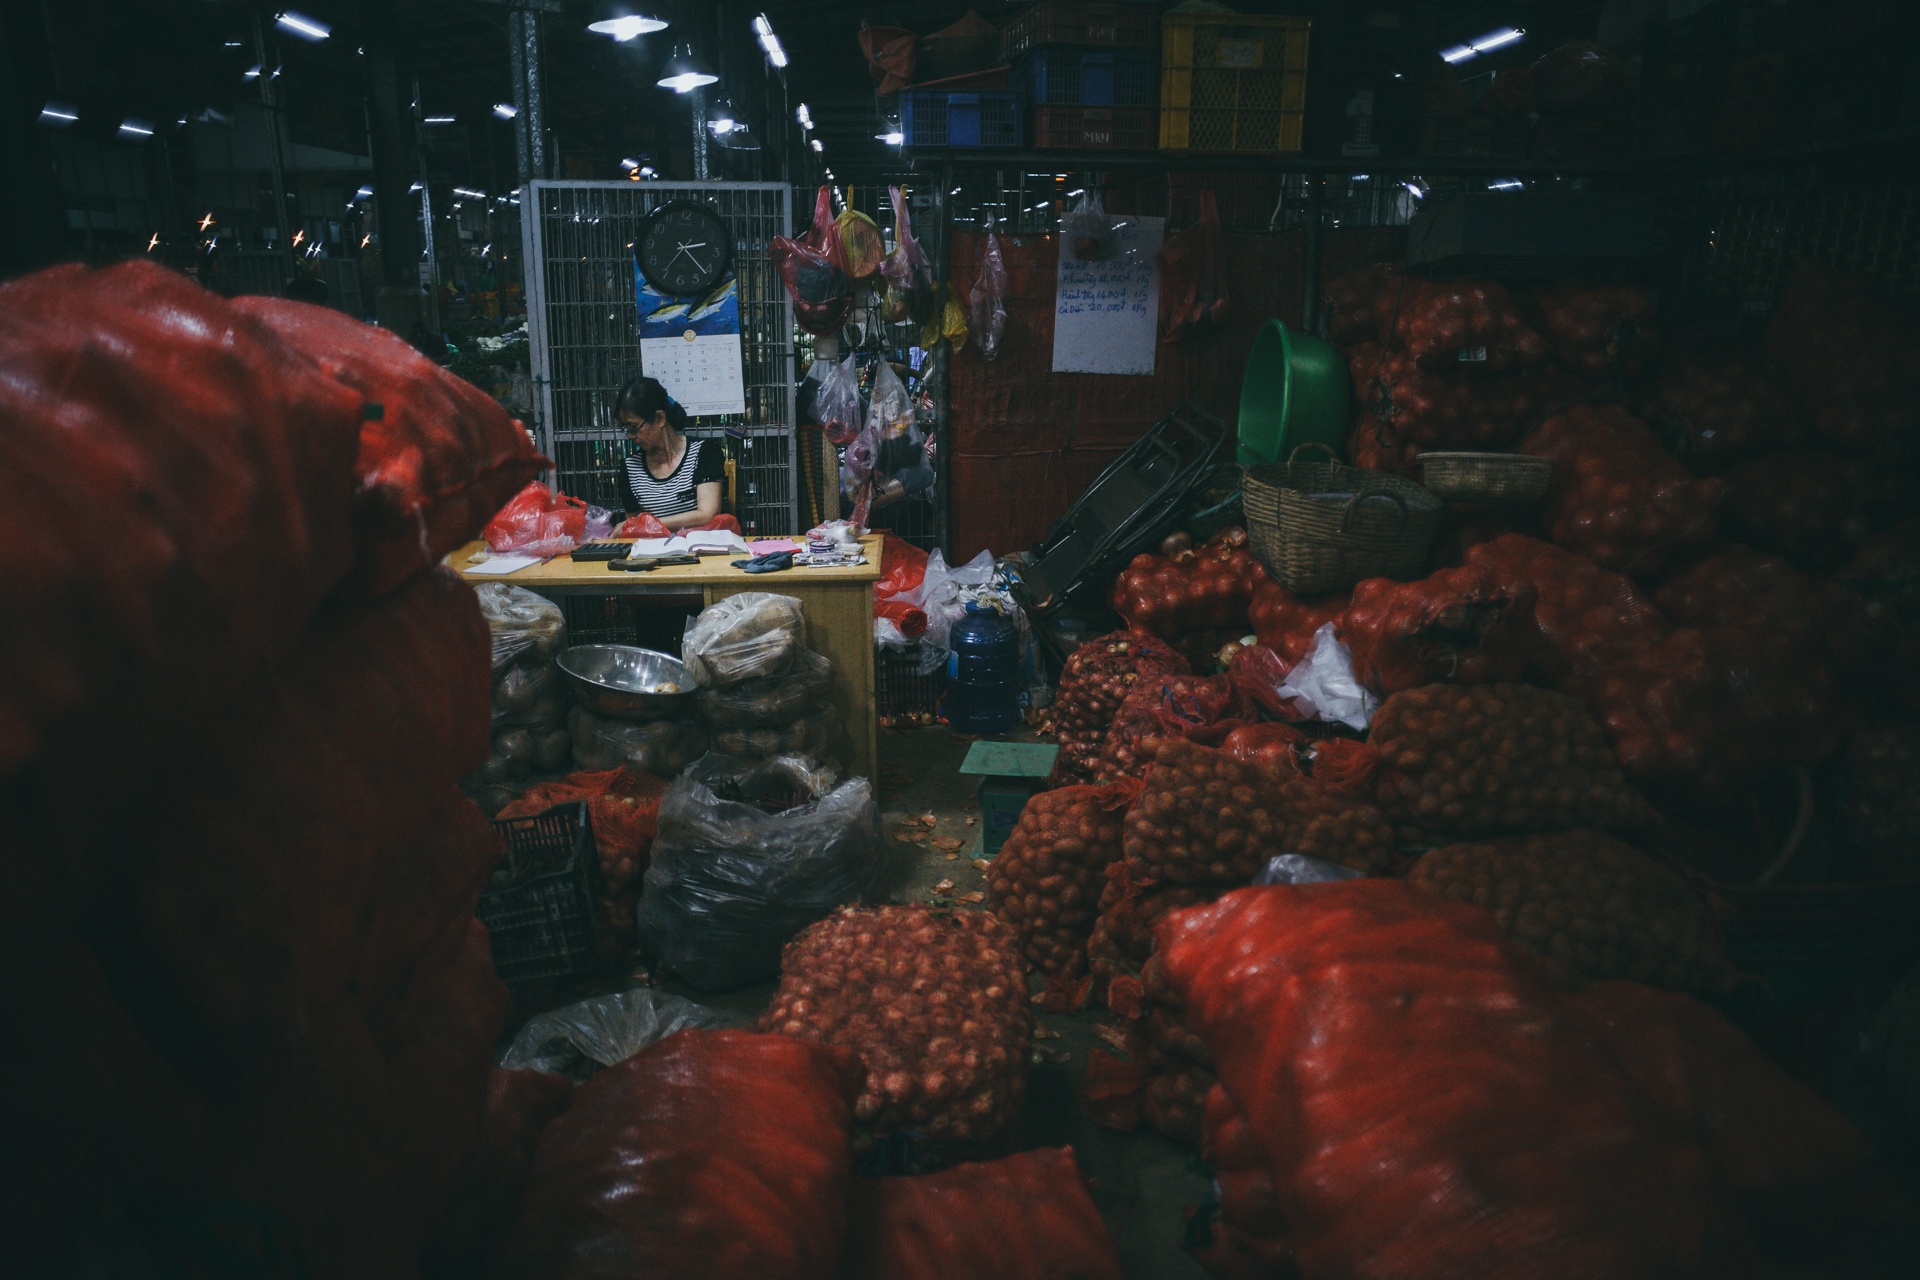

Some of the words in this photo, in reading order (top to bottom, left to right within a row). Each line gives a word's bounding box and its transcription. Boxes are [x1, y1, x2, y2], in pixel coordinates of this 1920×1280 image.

[666, 213, 673, 223] 11
[682, 210, 692, 221] 12
[701, 218, 705, 228] 1
[655, 223, 665, 234] 10
[708, 231, 716, 241] 2
[646, 239, 655, 249] 9
[713, 247, 720, 258] 3
[650, 256, 657, 266] 8
[662, 268, 669, 279] 7
[706, 263, 713, 274] 4
[676, 275, 685, 286] 6
[692, 274, 699, 284] 5
